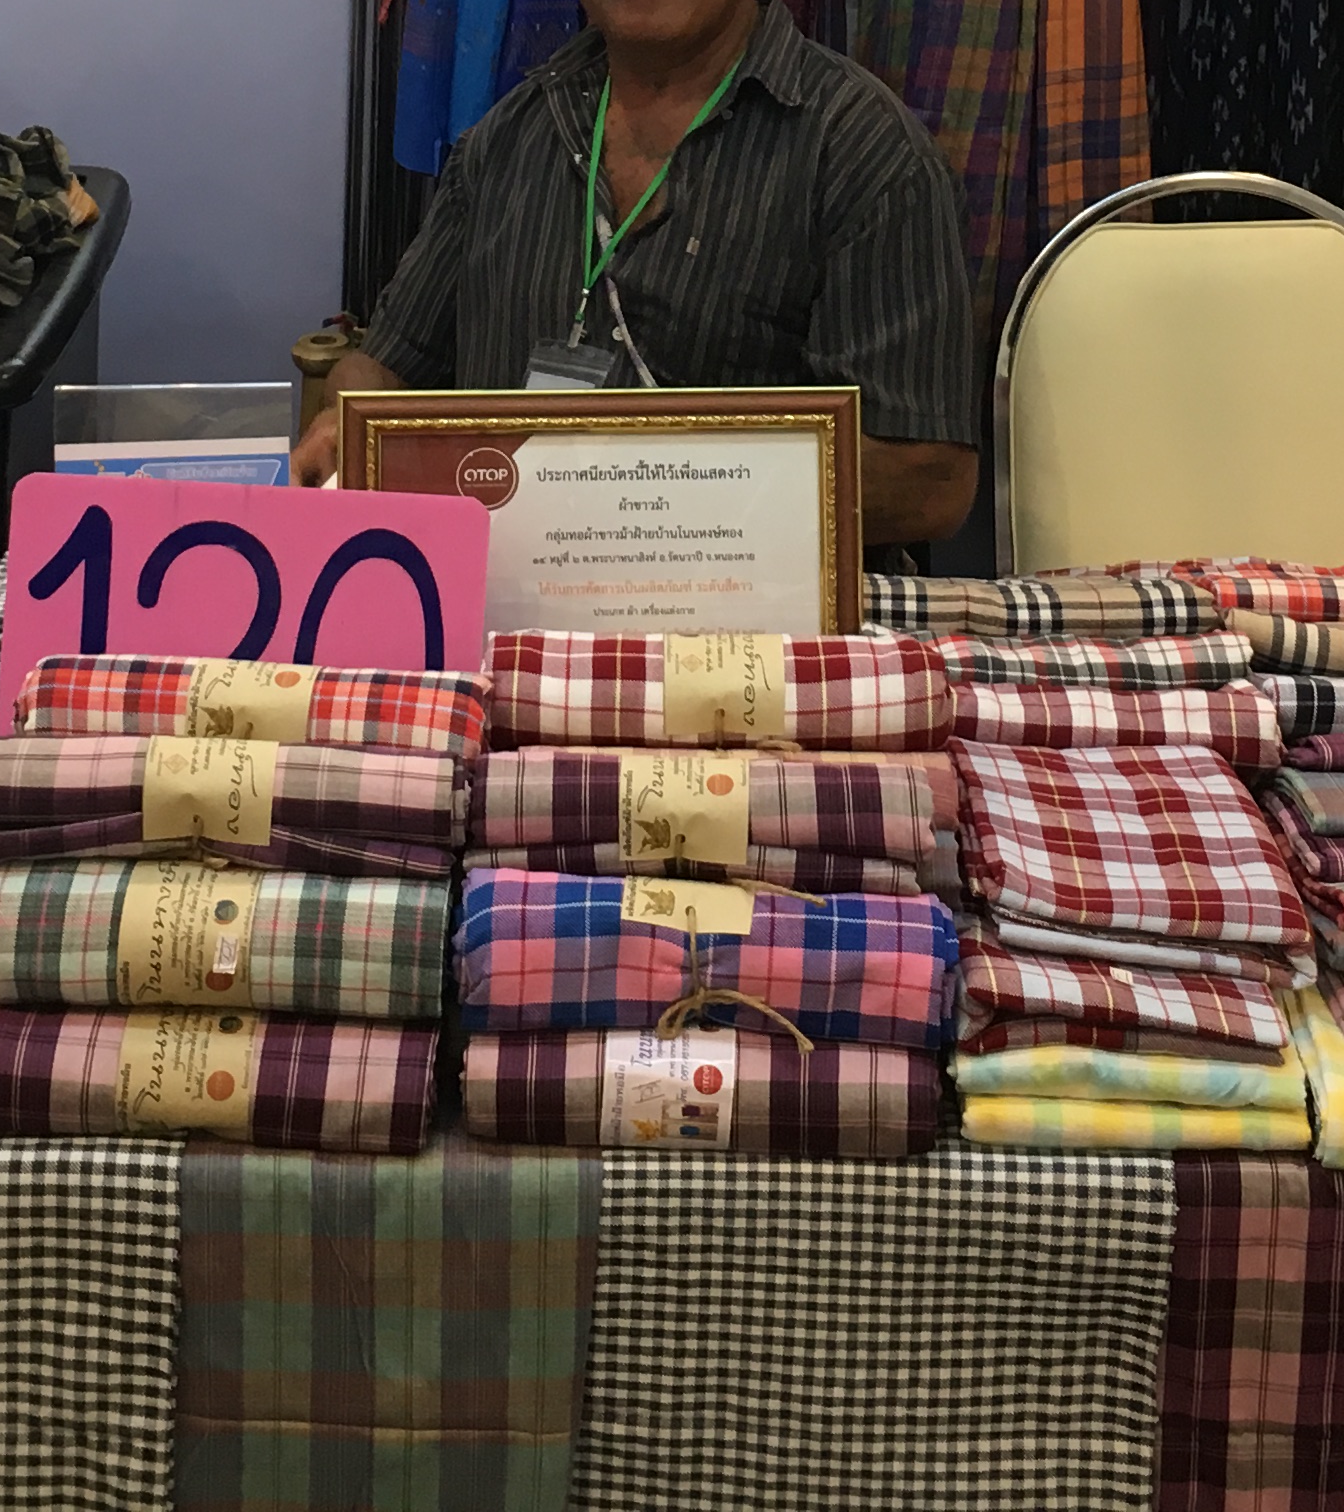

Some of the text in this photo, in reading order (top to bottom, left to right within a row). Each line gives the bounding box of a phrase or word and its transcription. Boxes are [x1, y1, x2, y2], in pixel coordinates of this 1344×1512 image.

[463, 468, 509, 482] OTOP
[536, 460, 751, 483] ประกาศนียบัตรนี้ให้ไว้เพื่อแสดงว่า
[618, 496, 670, 511] ผ้าขาวม้า
[28, 504, 445, 672] 120
